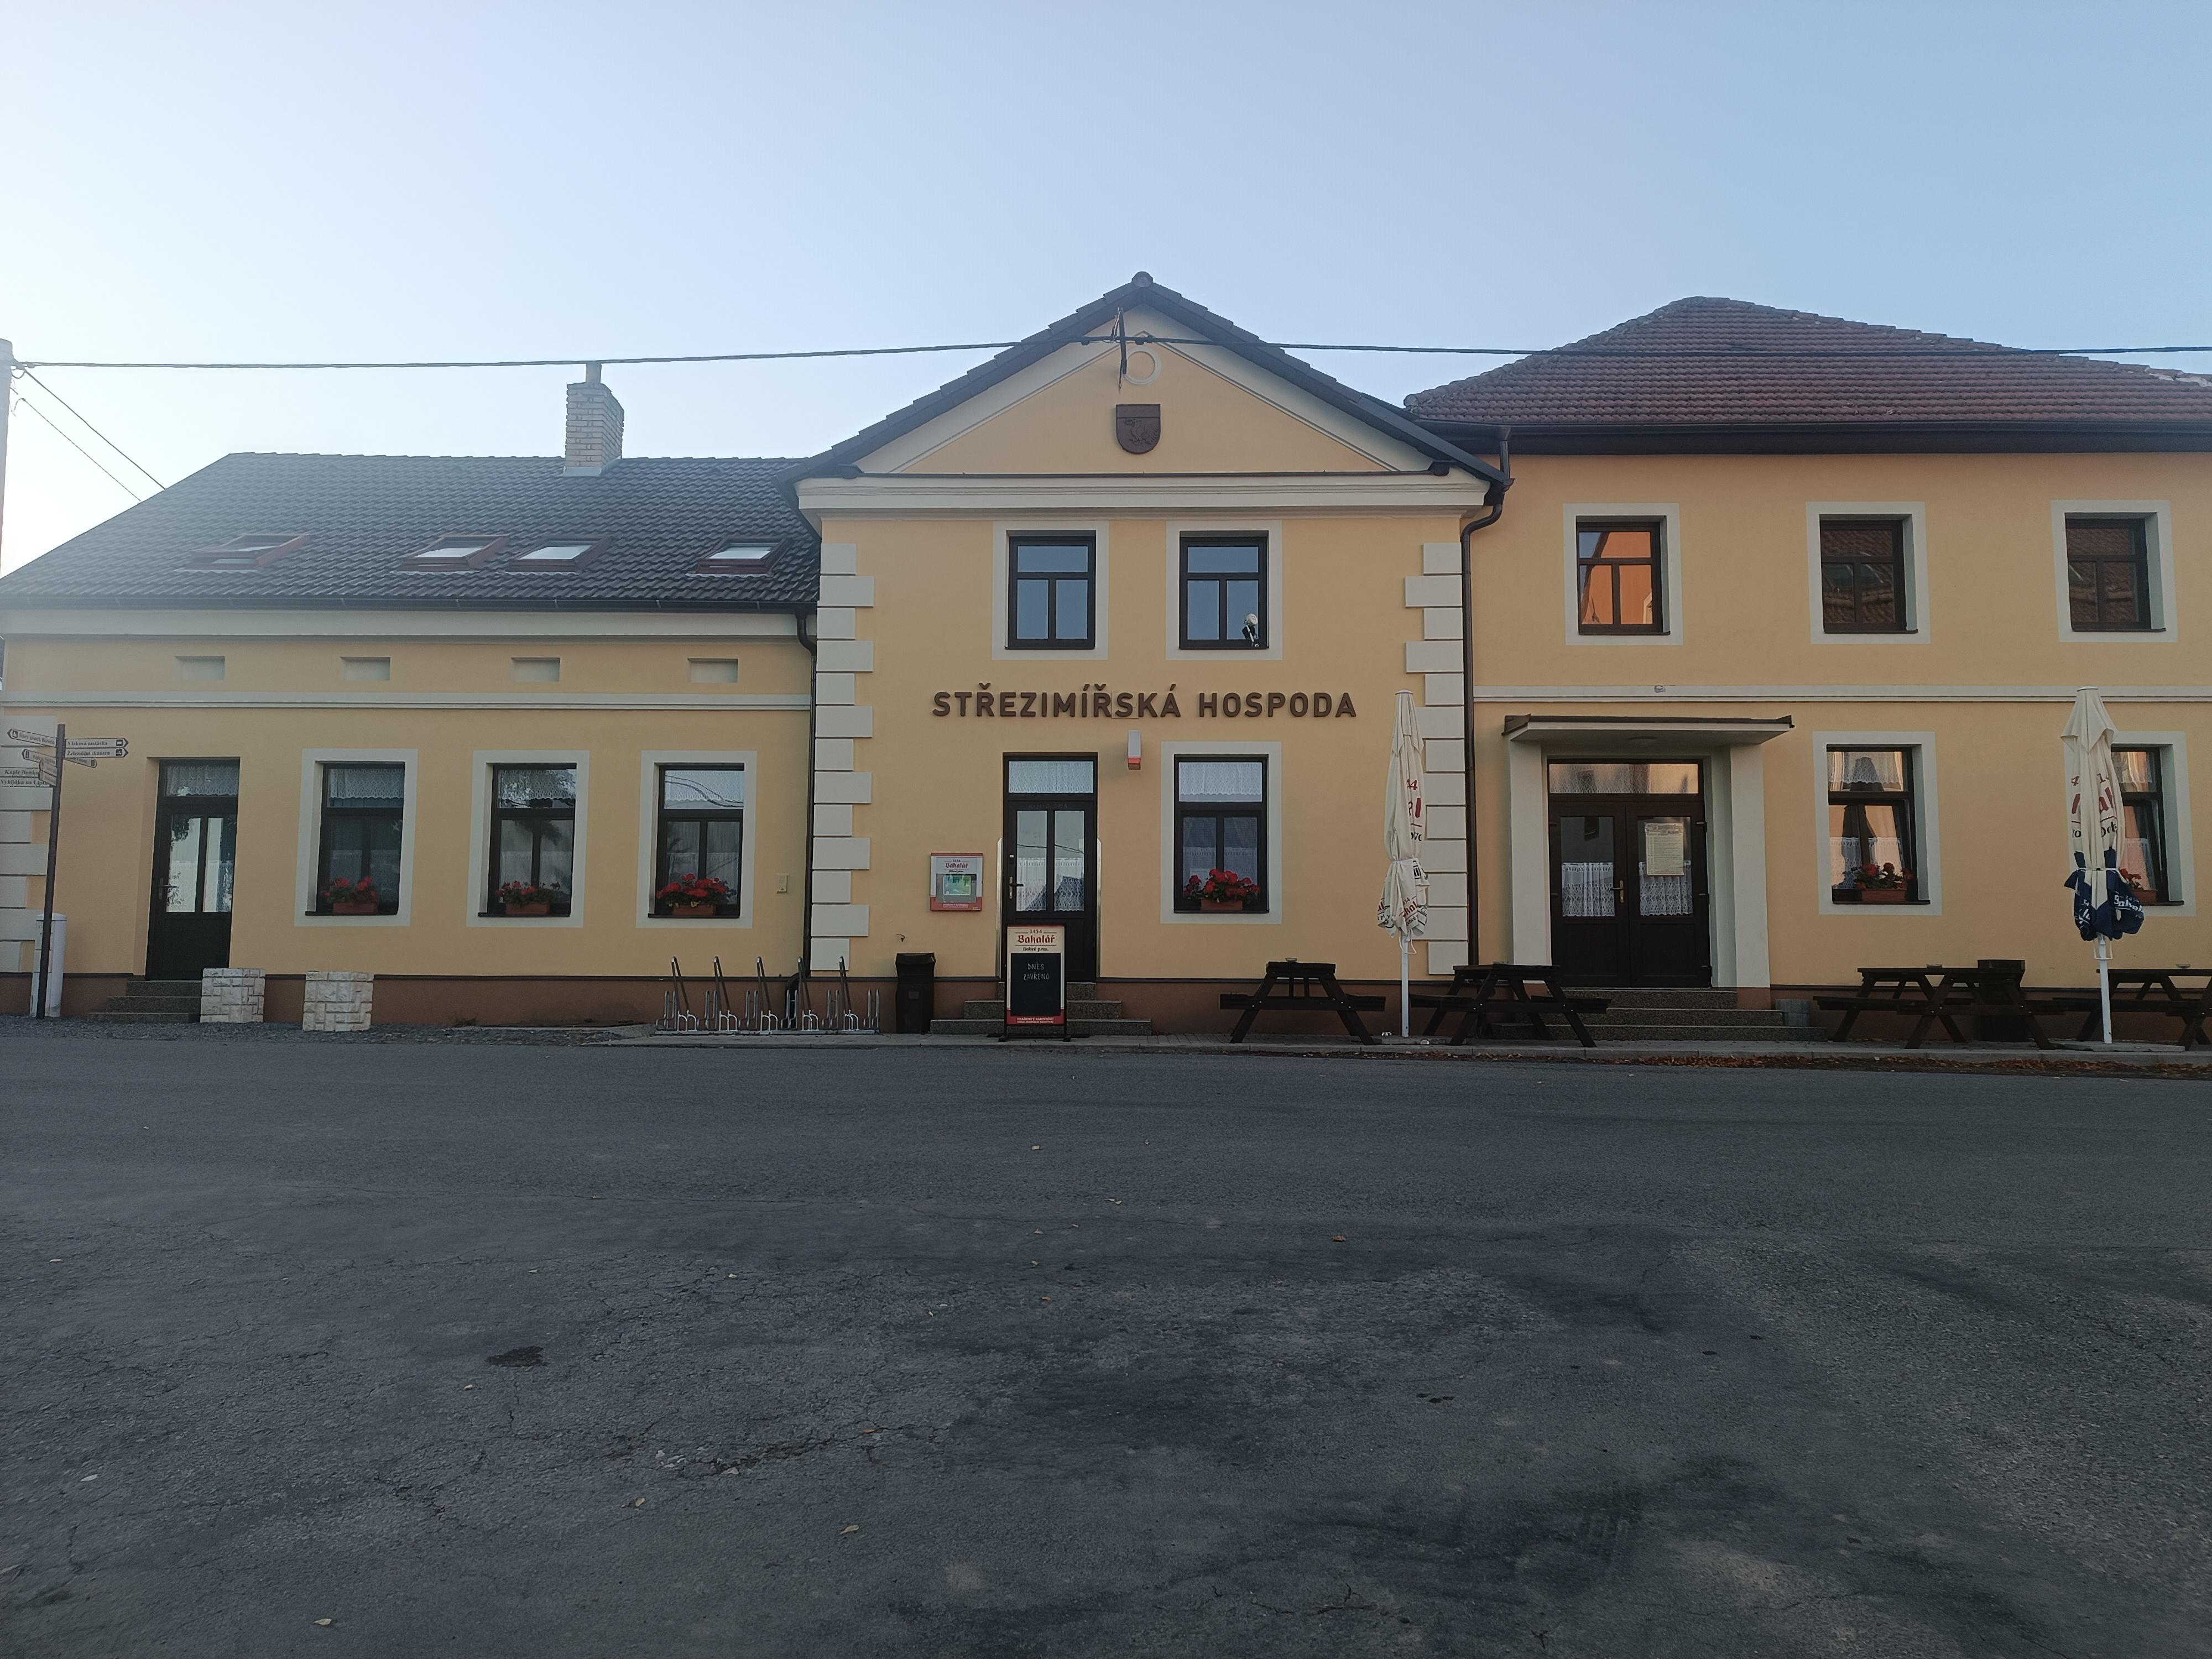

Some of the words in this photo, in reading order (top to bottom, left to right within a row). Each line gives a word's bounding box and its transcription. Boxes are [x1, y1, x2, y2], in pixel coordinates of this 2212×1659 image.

[932, 682, 1181, 718] STŘEZIMÍŘSKÁ
[1199, 691, 1357, 718] HOSPODA
[1017, 935, 1055, 943] Bakalář
[1023, 972, 1050, 980] ZAVŘENO
